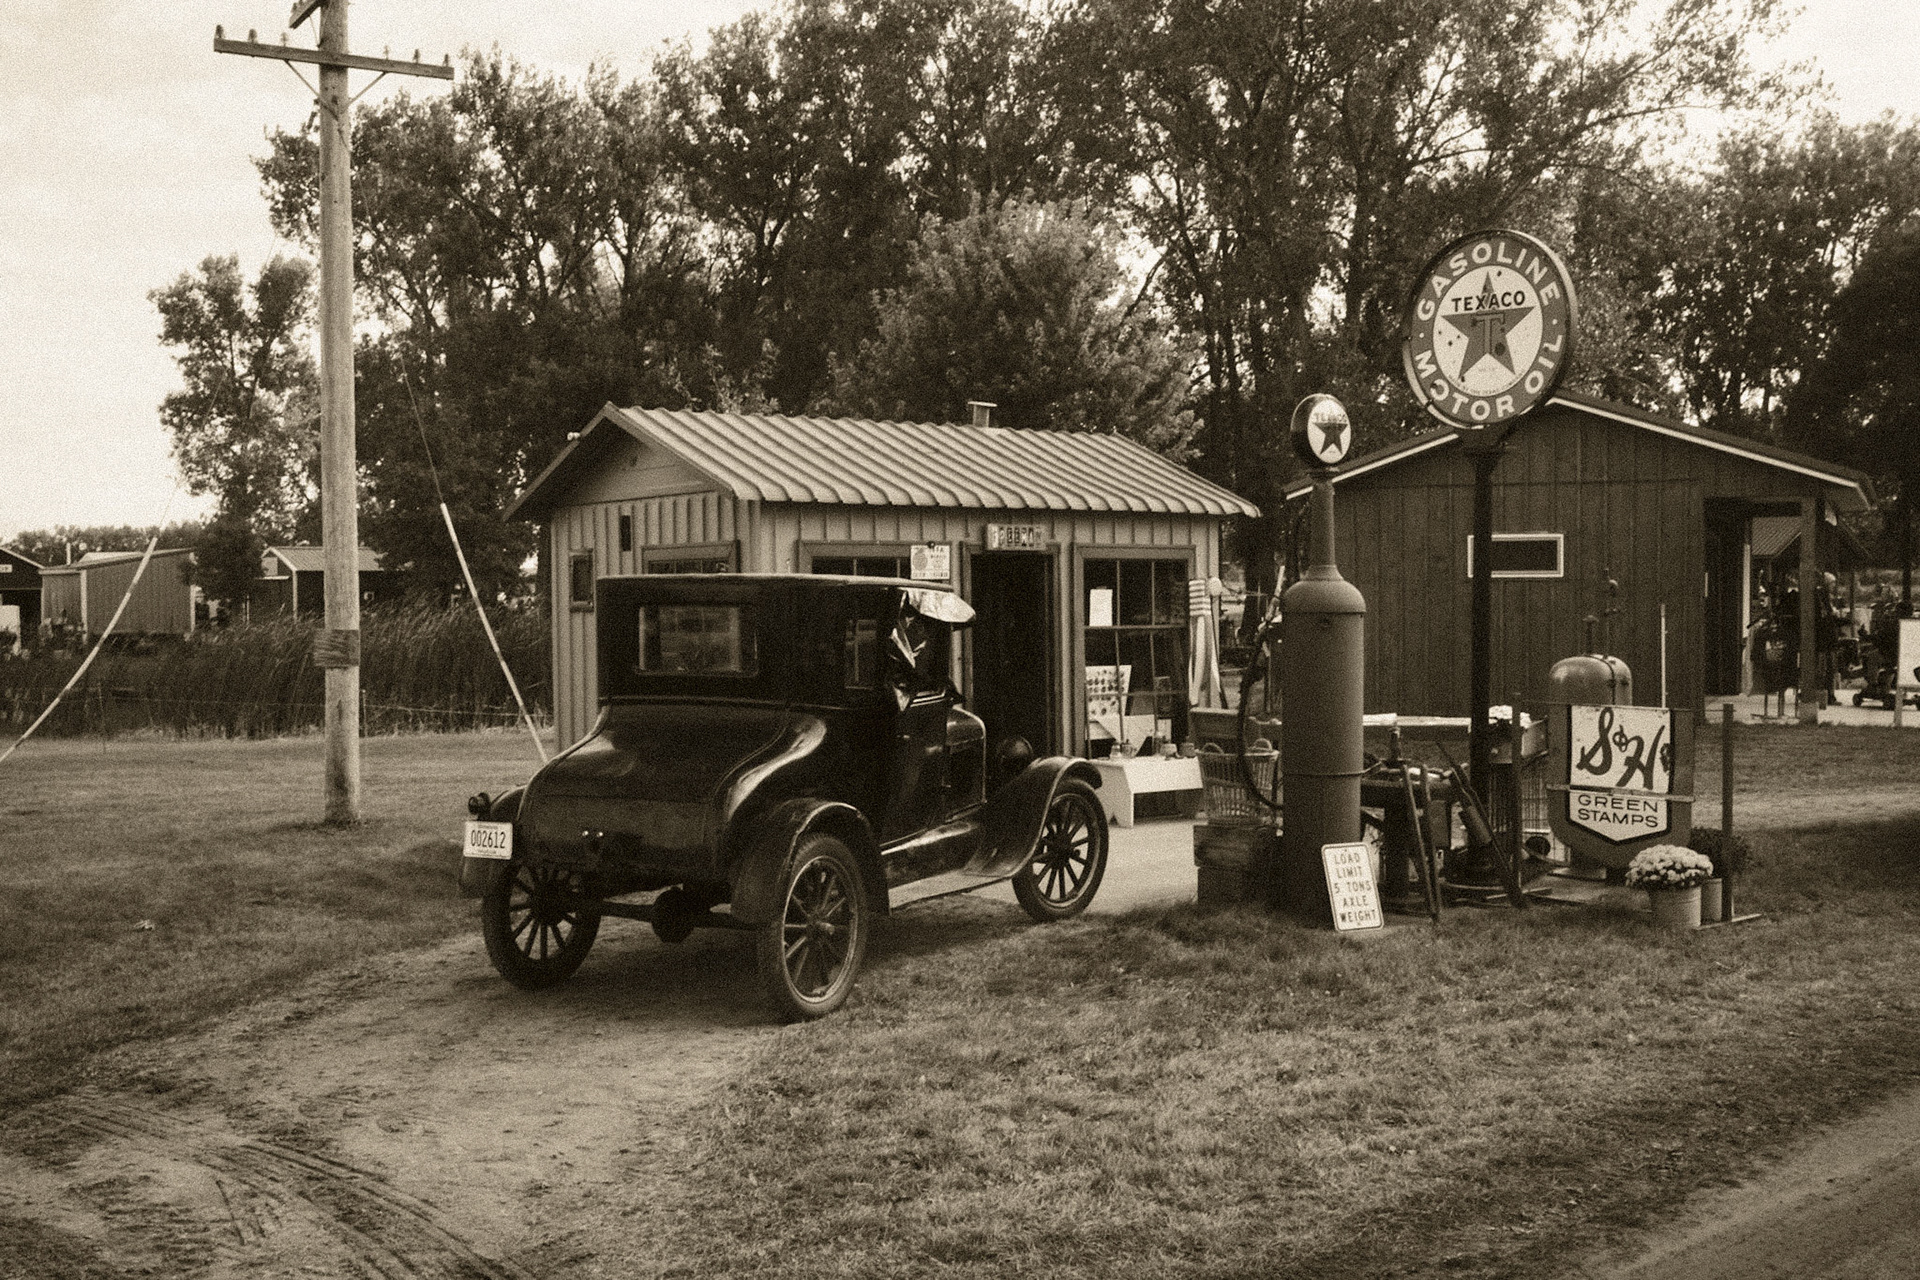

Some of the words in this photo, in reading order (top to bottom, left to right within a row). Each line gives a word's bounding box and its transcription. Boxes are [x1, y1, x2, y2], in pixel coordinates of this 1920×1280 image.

[1417, 242, 1560, 321] GASOLINE
[1452, 290, 1526, 313] TEXACO
[1415, 349, 1515, 421] MOTOR
[1524, 334, 1562, 394] OIL
[1578, 794, 1658, 813] GREEN
[1577, 808, 1659, 828] STAMPS
[470, 829, 506, 849] 002612
[1334, 852, 1360, 865] LOAD
[1336, 866, 1362, 879] LIMIT
[1334, 882, 1340, 894] 5
[1347, 880, 1372, 892] TONS
[1343, 895, 1369, 908] AXLE
[1339, 909, 1376, 922] WEIGHT
